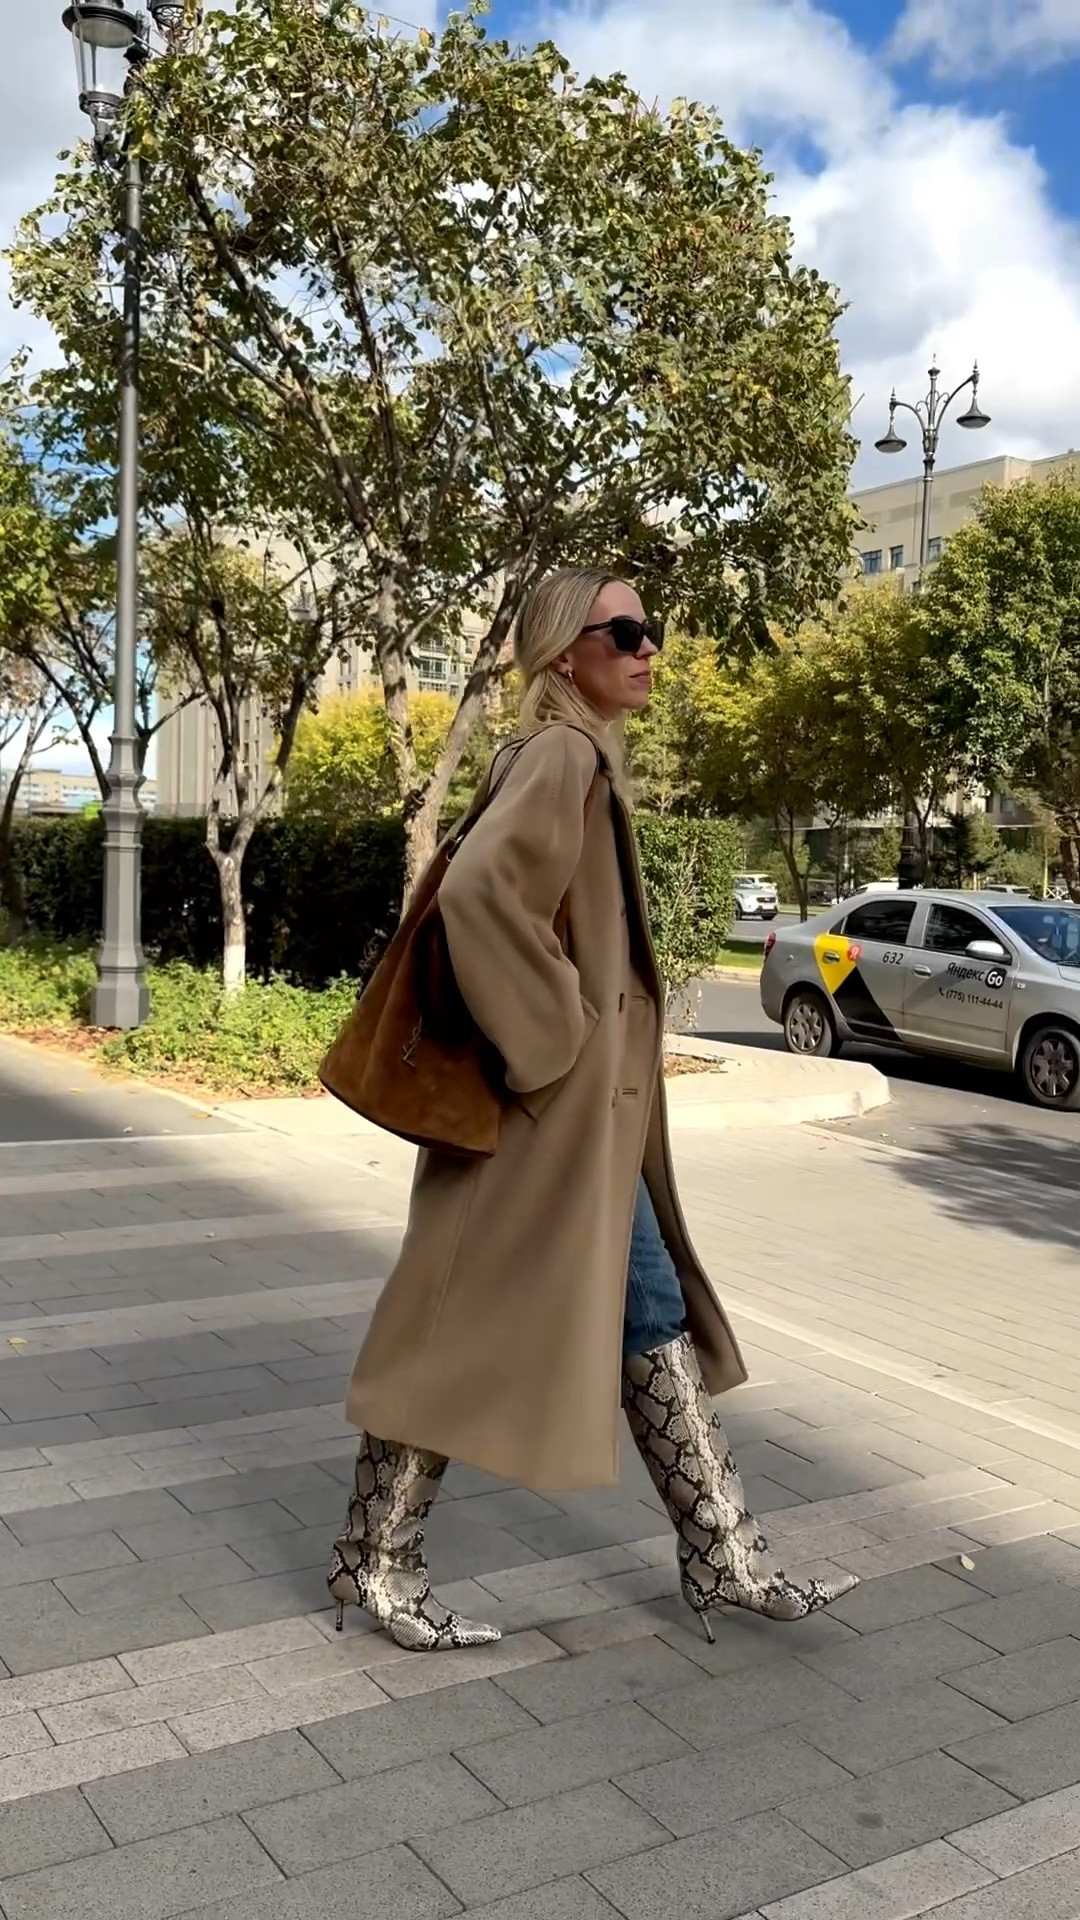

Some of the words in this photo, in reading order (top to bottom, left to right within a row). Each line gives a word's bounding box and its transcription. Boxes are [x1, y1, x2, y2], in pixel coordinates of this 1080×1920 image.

[882, 951, 904, 965] 632
[946, 962, 985, 981] Яндекс
[987, 971, 1003, 987] Go
